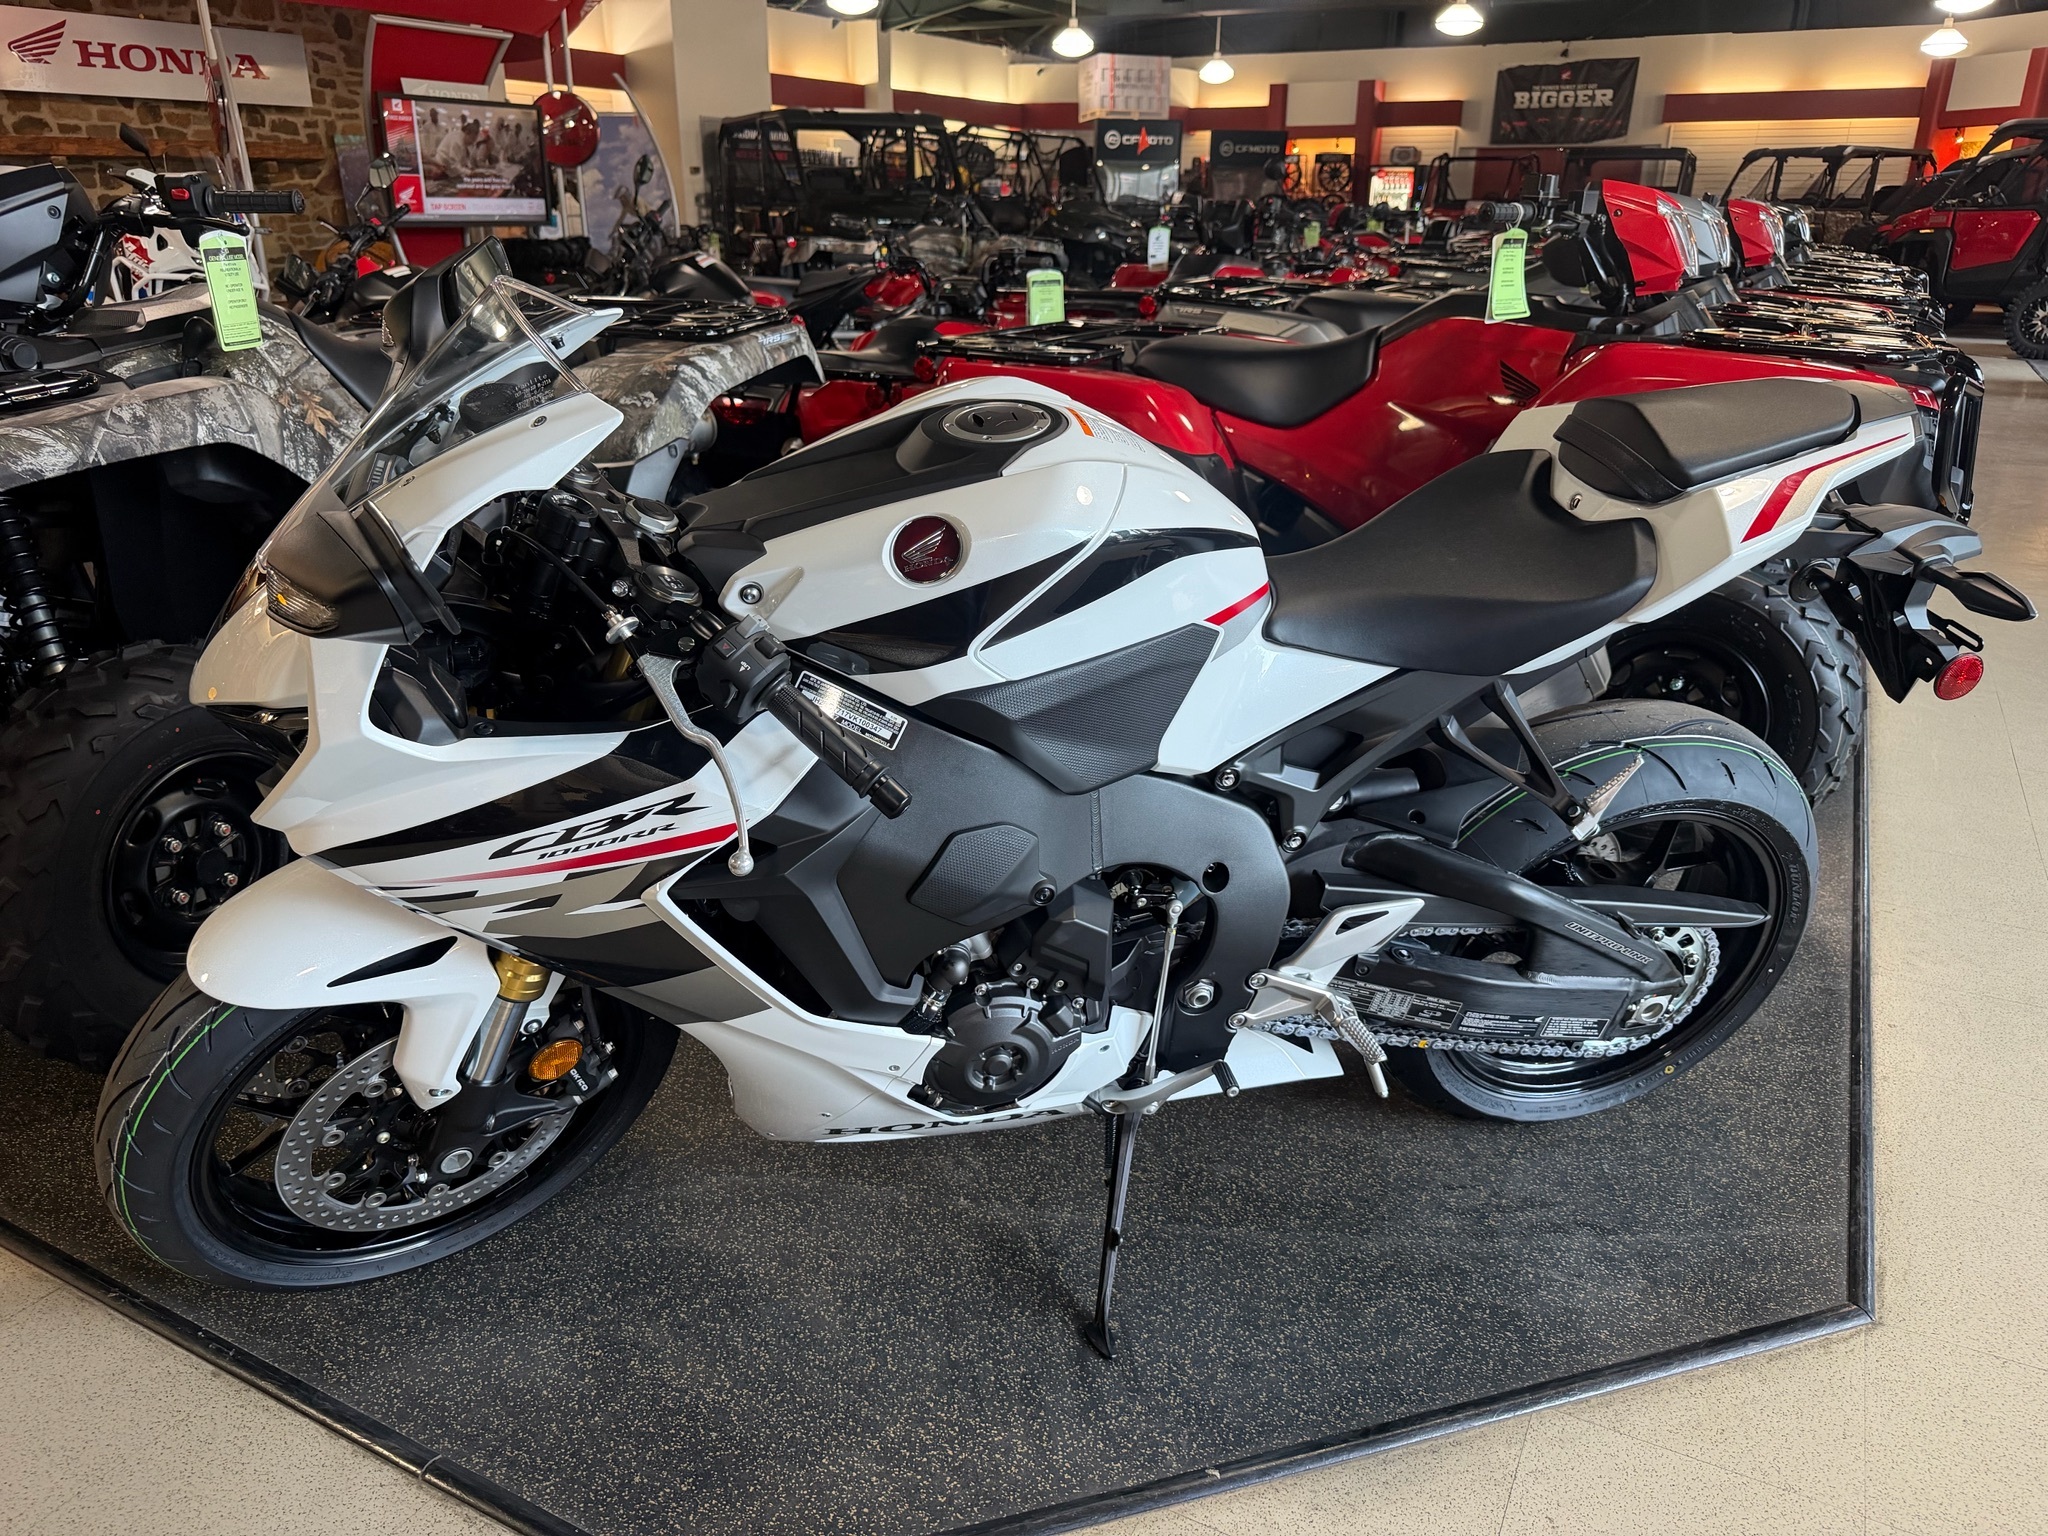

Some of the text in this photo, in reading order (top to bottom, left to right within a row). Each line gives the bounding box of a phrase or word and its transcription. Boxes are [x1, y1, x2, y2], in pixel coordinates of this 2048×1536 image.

[1513, 89, 1614, 110] BIGGER
[1121, 134, 1174, 146] CFOTO
[1234, 144, 1280, 155] CFMOTO
[762, 333, 782, 345] IRS
[904, 556, 954, 573] HONDA
[840, 718, 863, 733] MODEL
[488, 792, 713, 861] CBR
[536, 822, 680, 861] 1000RR
[569, 1068, 589, 1092] OKICO
[825, 1109, 1069, 1136] HONDA
